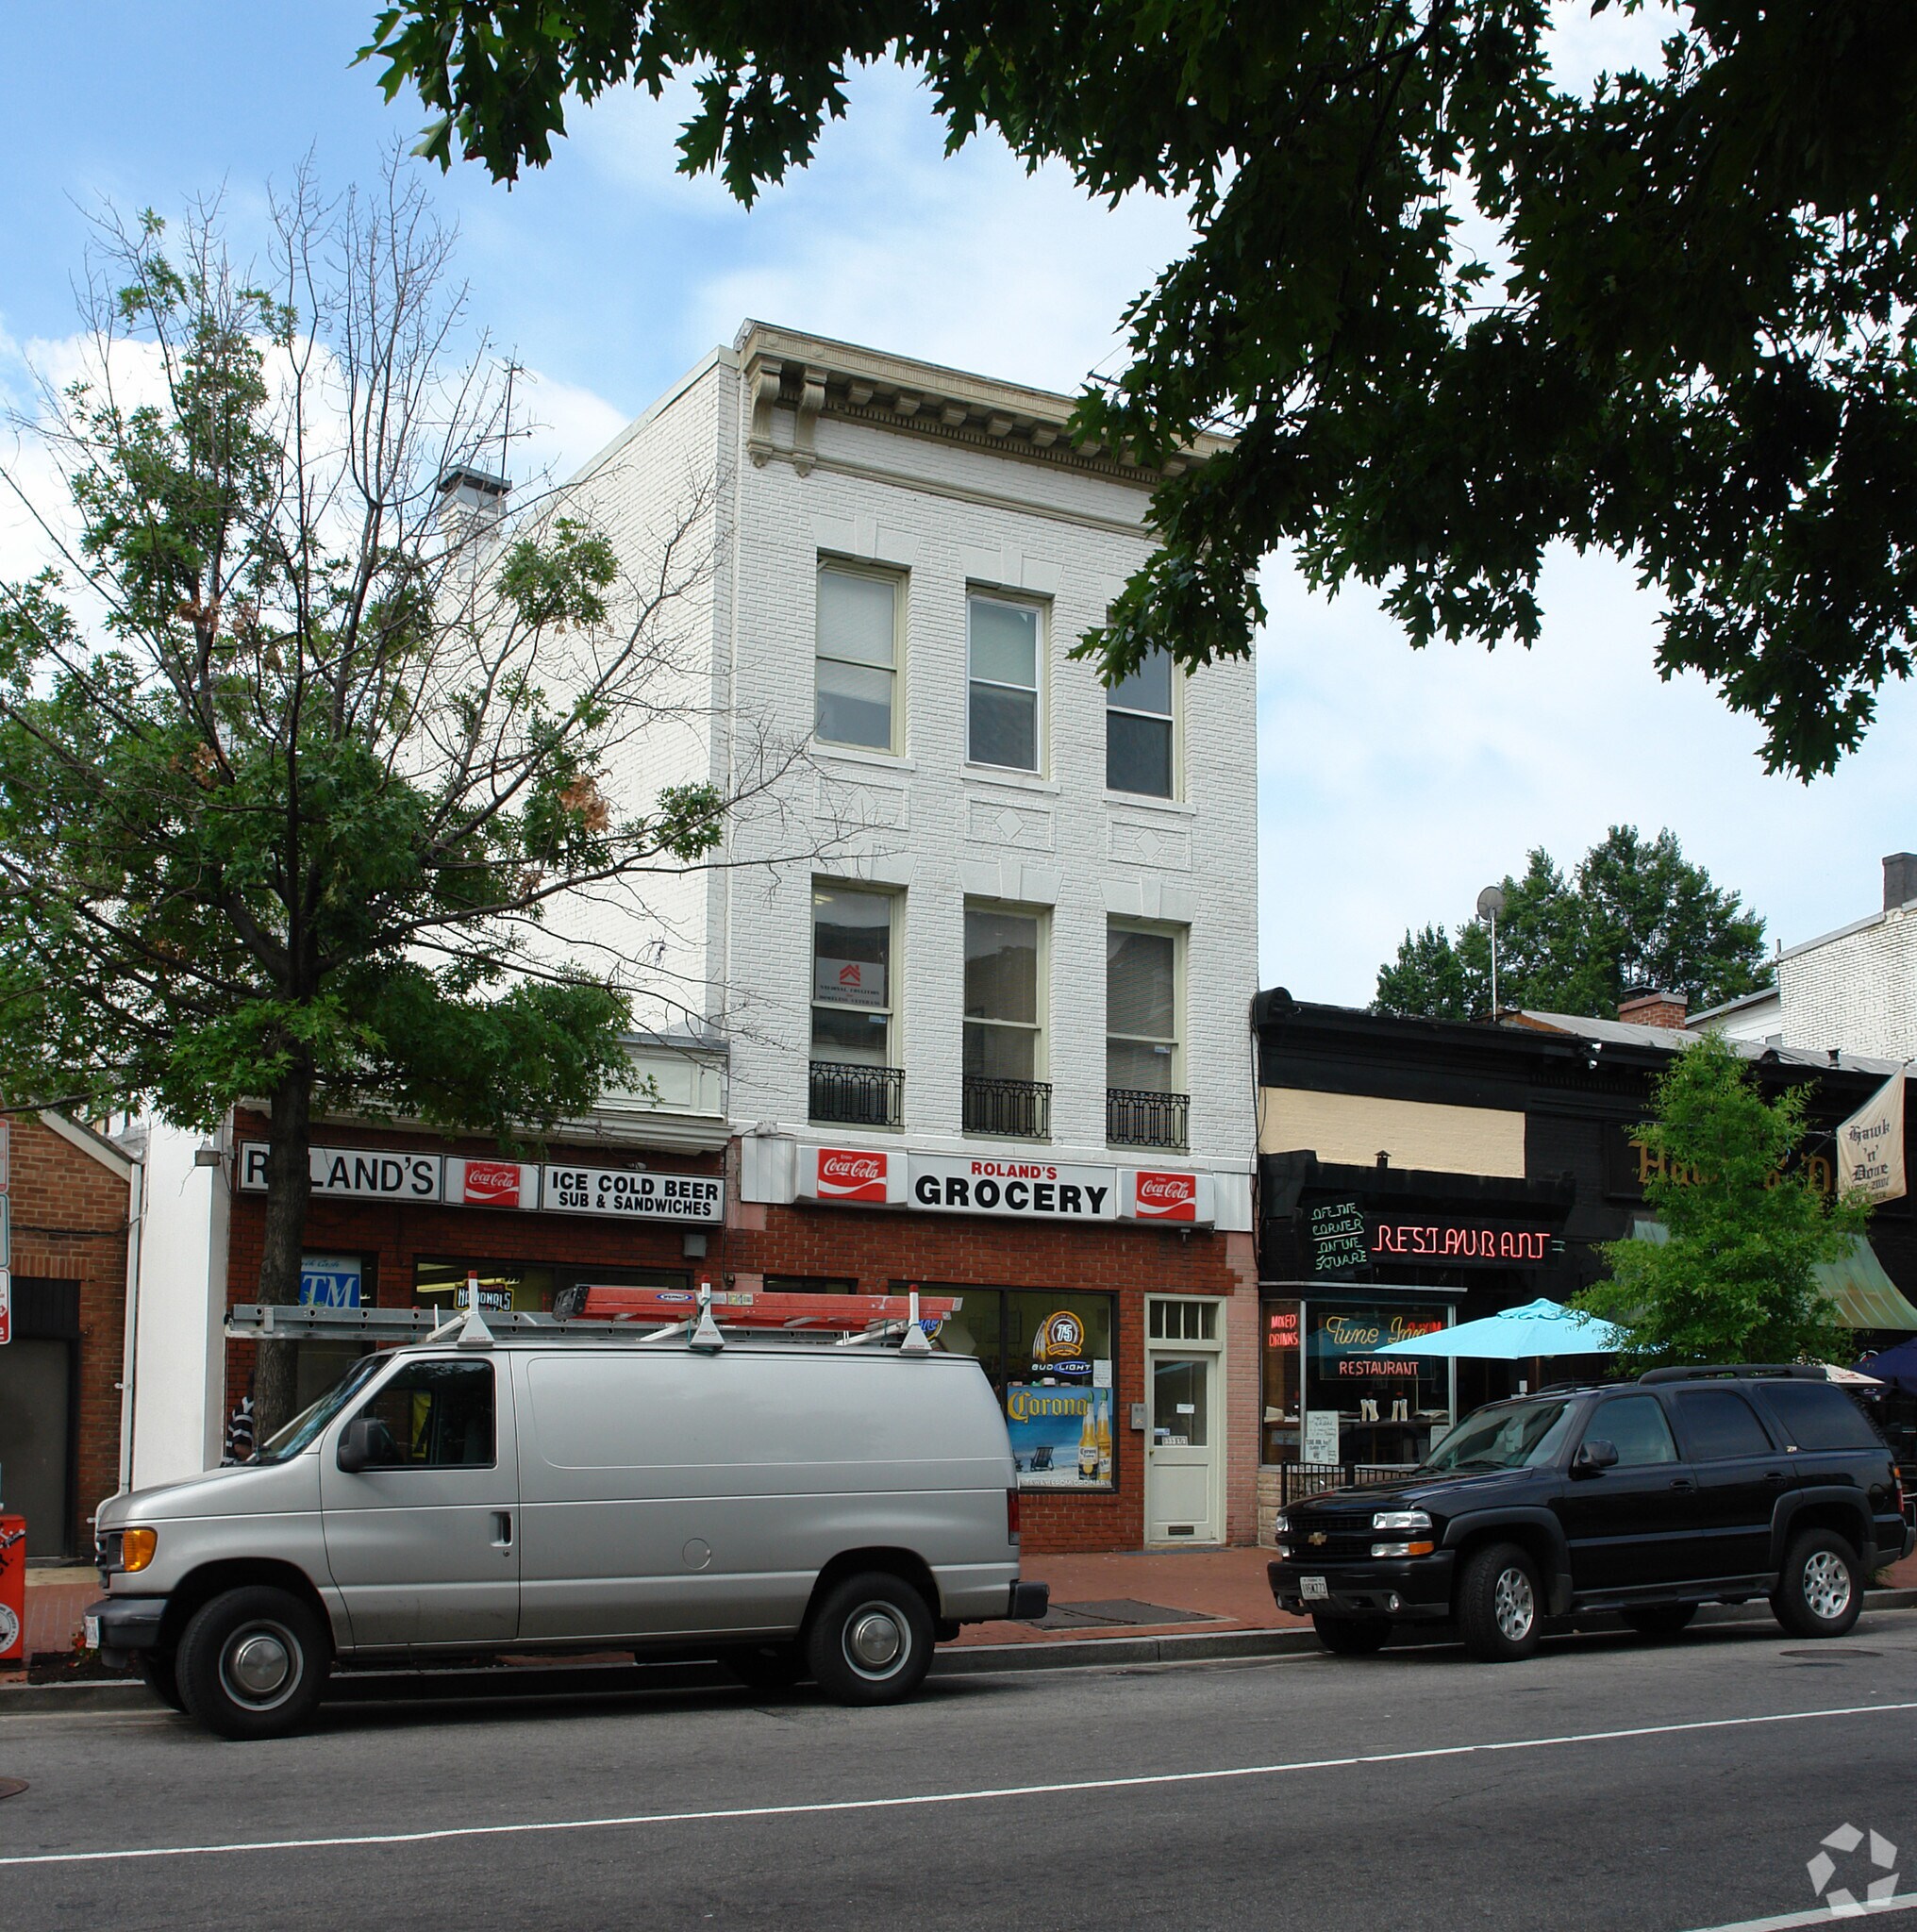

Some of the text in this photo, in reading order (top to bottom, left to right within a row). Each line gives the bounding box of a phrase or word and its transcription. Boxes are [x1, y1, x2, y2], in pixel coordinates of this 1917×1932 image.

[1849, 1119, 1891, 1145] Hawk
[247, 1150, 434, 1195] RAND'S
[468, 1169, 514, 1189] Coca-Cola
[823, 1157, 880, 1179] Coca-Cola
[971, 1160, 1058, 1180] ROLAND'S
[552, 1171, 719, 1201] ICE COLD BEER
[914, 1174, 1109, 1214] GROCERY
[1141, 1178, 1190, 1199] Coca-Cola
[558, 1191, 712, 1217] SUB & SANDWICHES
[1312, 1218, 1363, 1236] CORNER
[1371, 1224, 1551, 1259] RESTAURANT
[1315, 1250, 1367, 1271] SQUARE
[303, 1274, 357, 1307] TM
[1271, 1313, 1297, 1329] MIXED
[1325, 1316, 1379, 1345] Tune
[1057, 1324, 1073, 1342] 75
[1268, 1332, 1299, 1347] DRINKS
[1339, 1360, 1420, 1376] RESTAURANT
[1007, 1391, 1088, 1424] Corona
